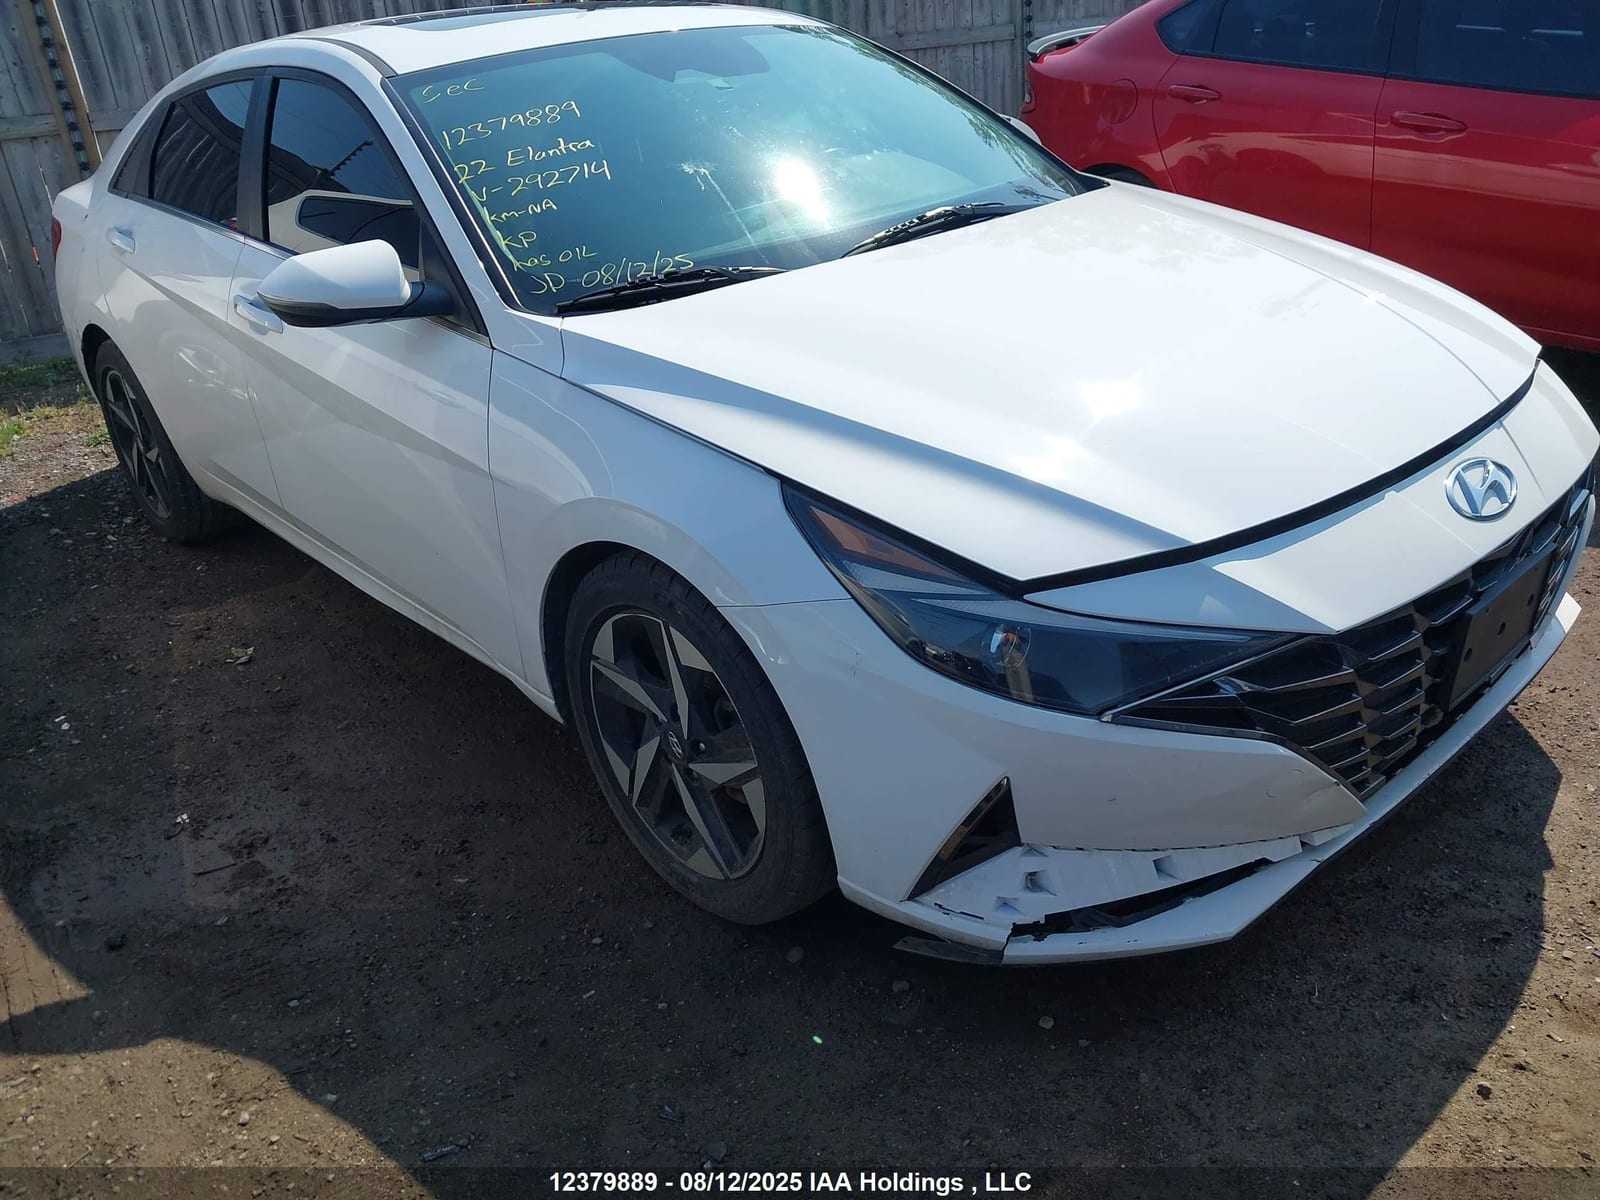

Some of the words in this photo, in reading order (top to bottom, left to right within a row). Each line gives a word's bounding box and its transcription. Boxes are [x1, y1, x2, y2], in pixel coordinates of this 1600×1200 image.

[442, 100, 581, 150] 12379889
[454, 159, 496, 184] 22
[506, 137, 595, 167] Elantra
